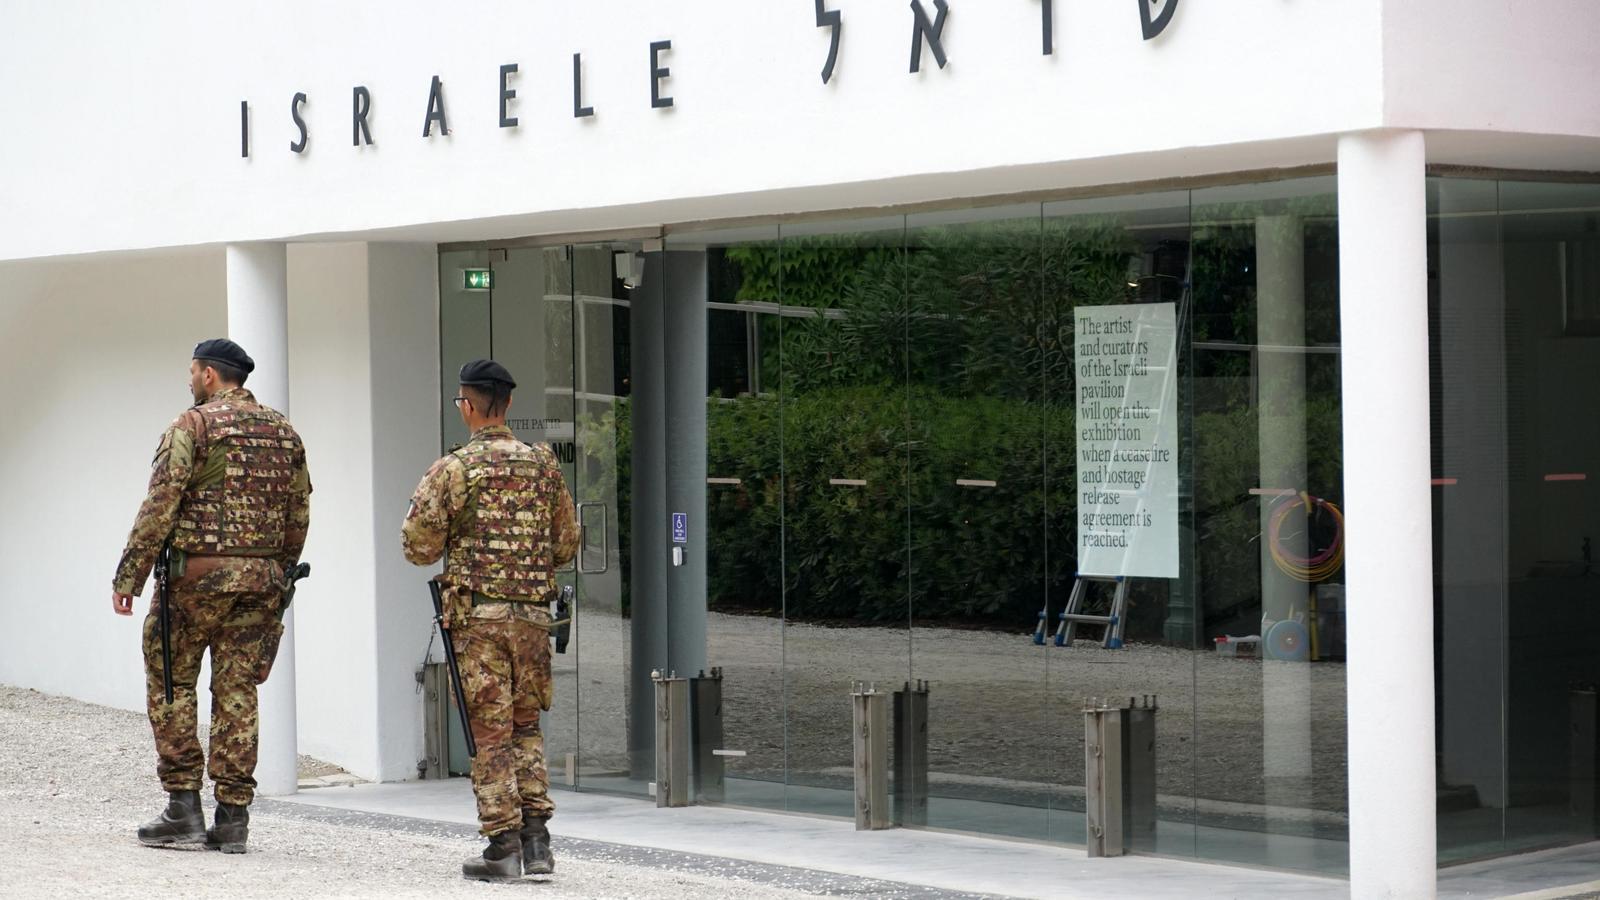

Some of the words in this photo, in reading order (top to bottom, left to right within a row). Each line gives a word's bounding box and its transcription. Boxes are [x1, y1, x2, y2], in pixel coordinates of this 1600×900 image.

[241, 40, 674, 157] ISRAELE
[1080, 317, 1104, 335] The
[1104, 316, 1133, 334] artist
[1080, 337, 1100, 356] and
[1102, 341, 1148, 356] curators
[1081, 359, 1093, 378] of
[1094, 359, 1111, 377] the
[1114, 358, 1148, 377] Israeli
[1081, 380, 1125, 404] pavilion
[1081, 401, 1100, 420] will
[1103, 406, 1130, 425] open
[1132, 400, 1150, 419] the
[504, 418, 529, 430] UTH
[1081, 422, 1141, 441] exhibition
[1082, 443, 1111, 462] when
[1113, 449, 1119, 462] a
[1121, 443, 1170, 462] ceasefire
[1082, 465, 1102, 484] and
[1104, 465, 1146, 489] hostage
[1082, 486, 1120, 505] release
[1082, 512, 1141, 531] agreement
[1143, 508, 1152, 527] is
[1082, 529, 1128, 548] reached.
